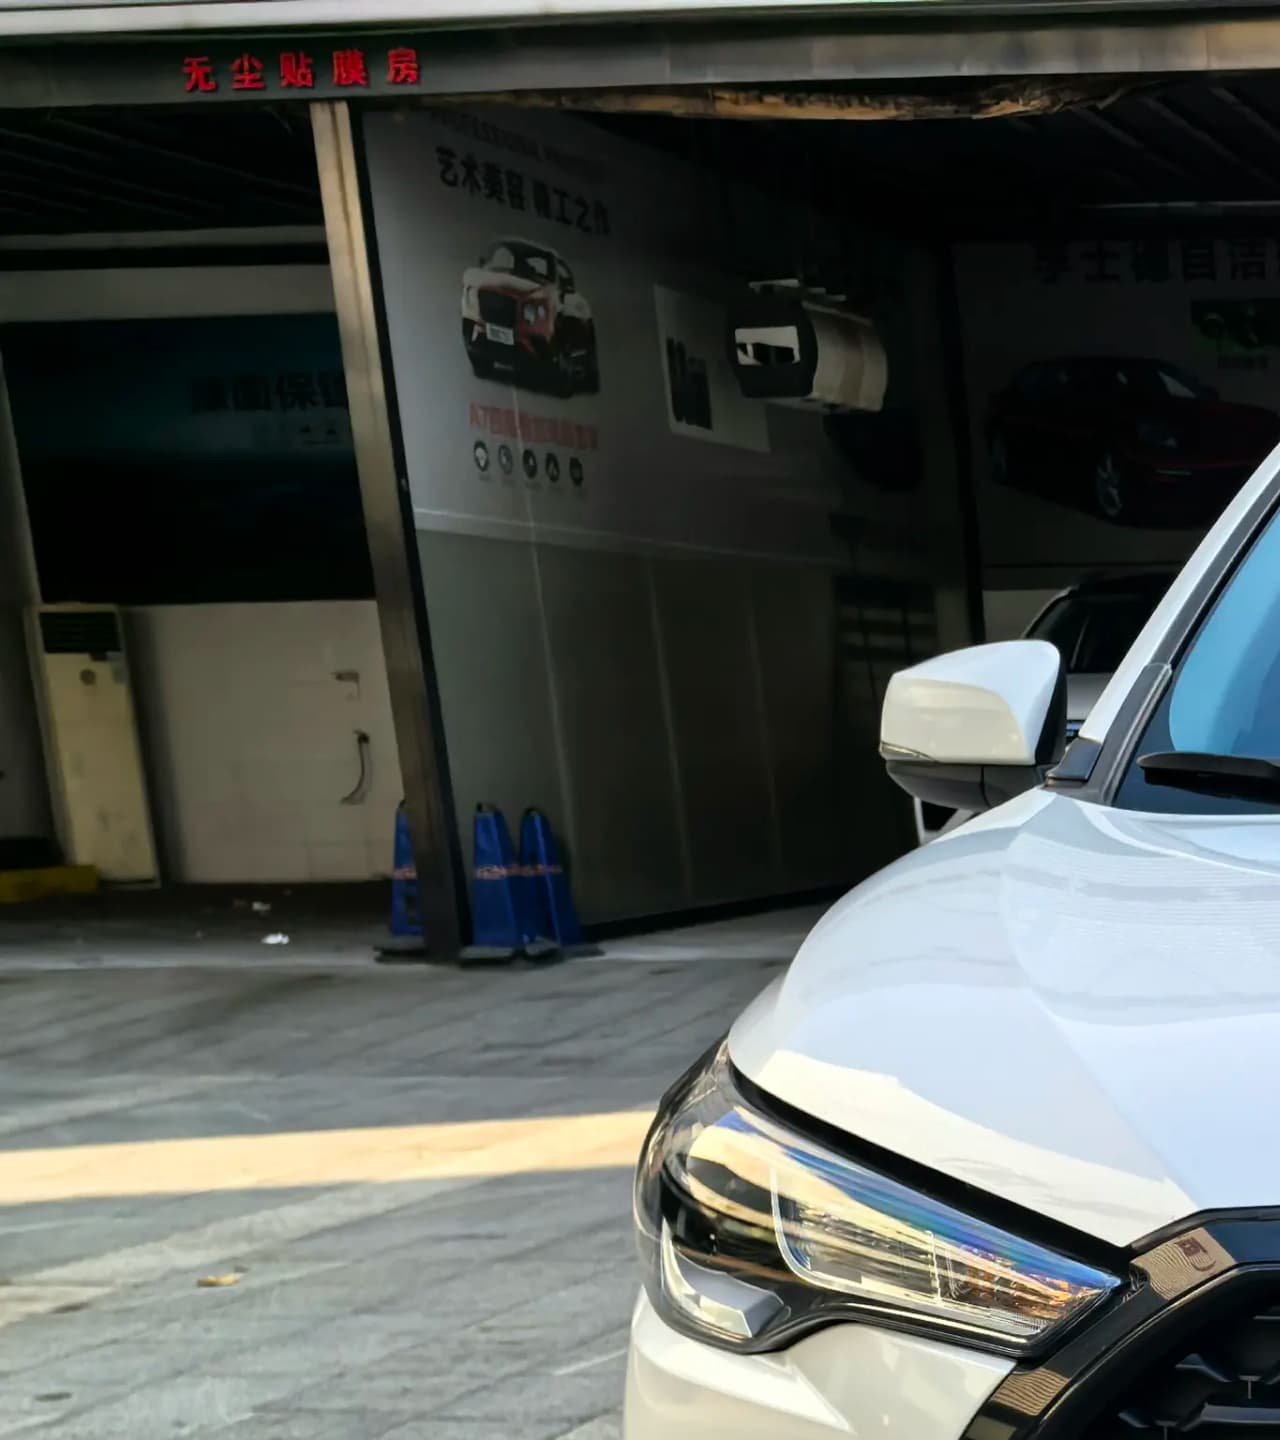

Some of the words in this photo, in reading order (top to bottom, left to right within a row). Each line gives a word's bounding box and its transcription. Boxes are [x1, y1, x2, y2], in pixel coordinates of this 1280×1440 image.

[182, 46, 419, 92] 无尘贴膜房
